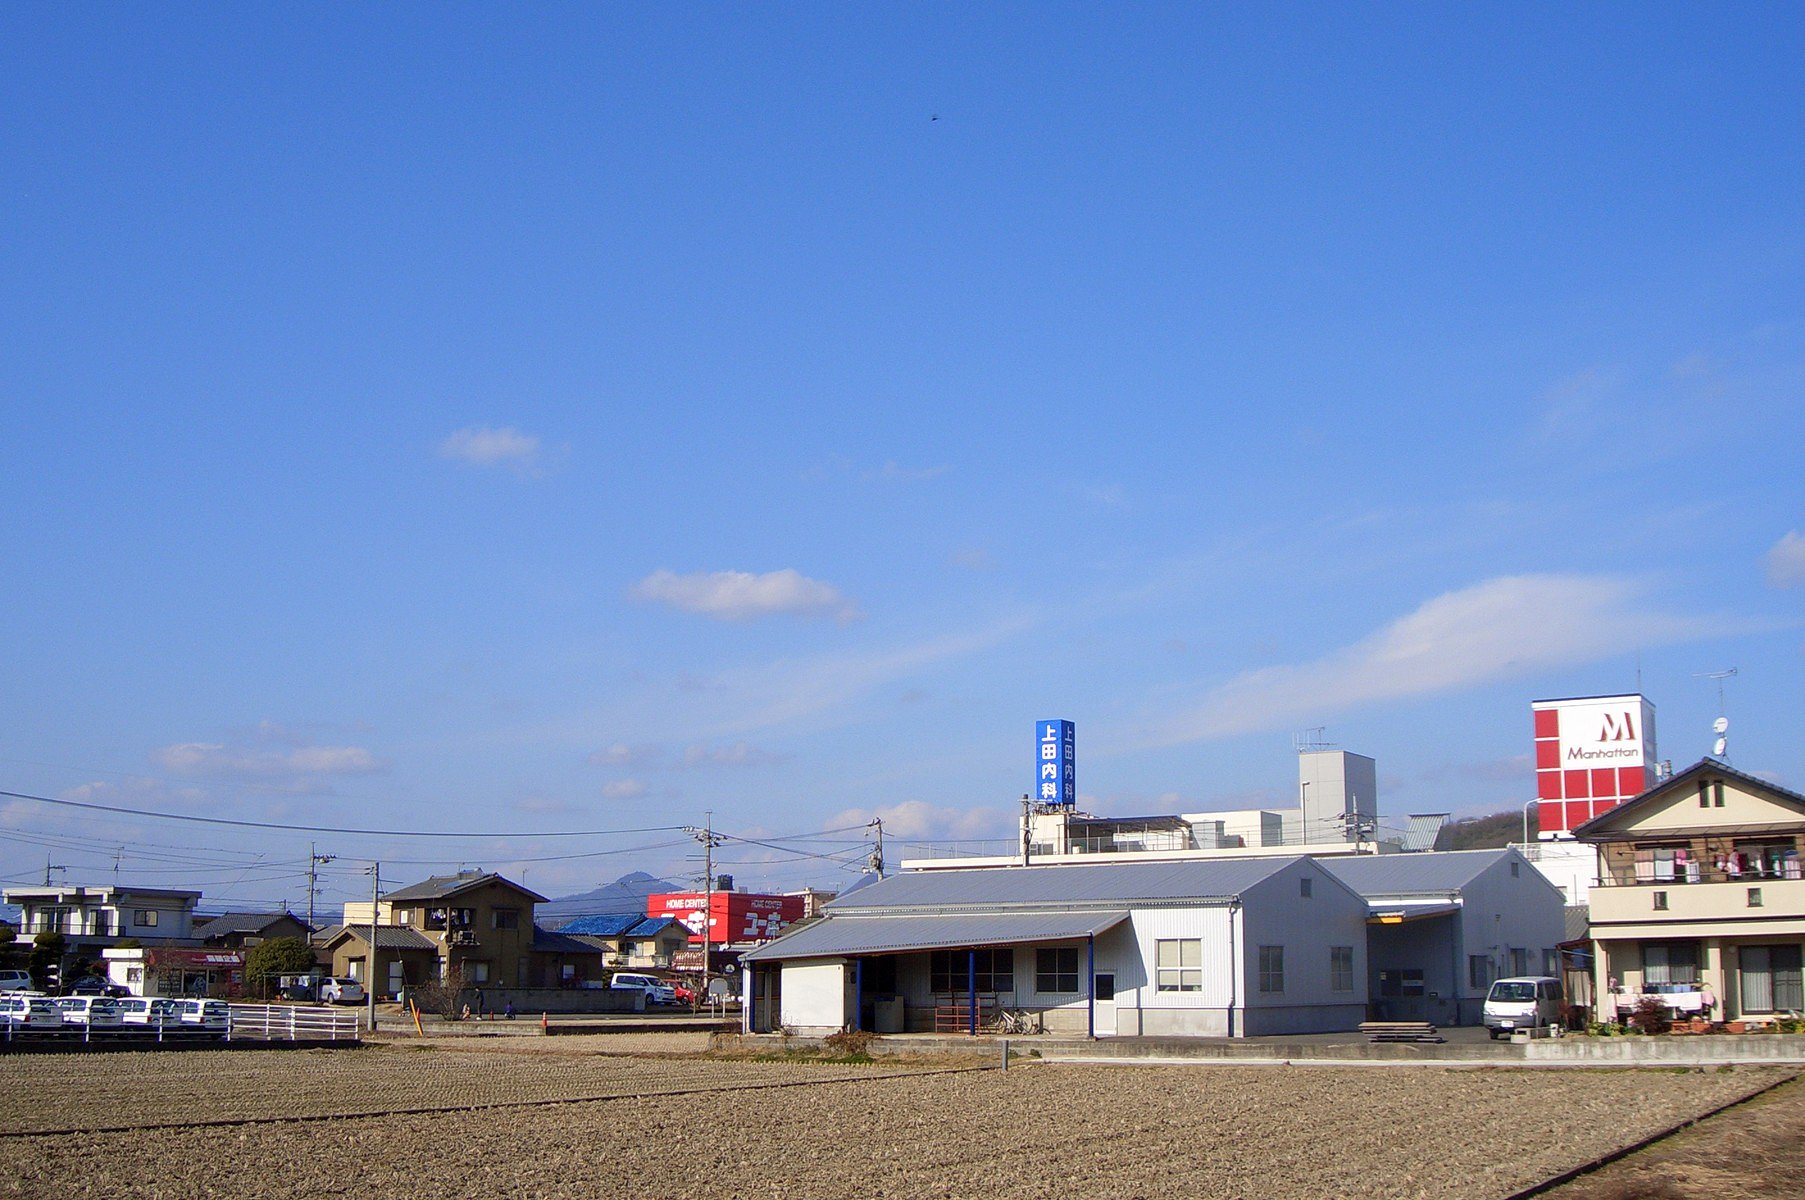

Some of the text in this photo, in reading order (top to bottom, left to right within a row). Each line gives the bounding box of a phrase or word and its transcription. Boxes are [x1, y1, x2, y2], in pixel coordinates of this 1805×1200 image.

[1596, 712, 1636, 742] M
[1041, 724, 1057, 799] 上田内科
[1064, 725, 1073, 799] 上田内科
[1567, 746, 1638, 760] Manhattan
[666, 898, 708, 909] HOME CENTE
[751, 900, 783, 909] HOME CENTER
[661, 911, 717, 935] ーホー
